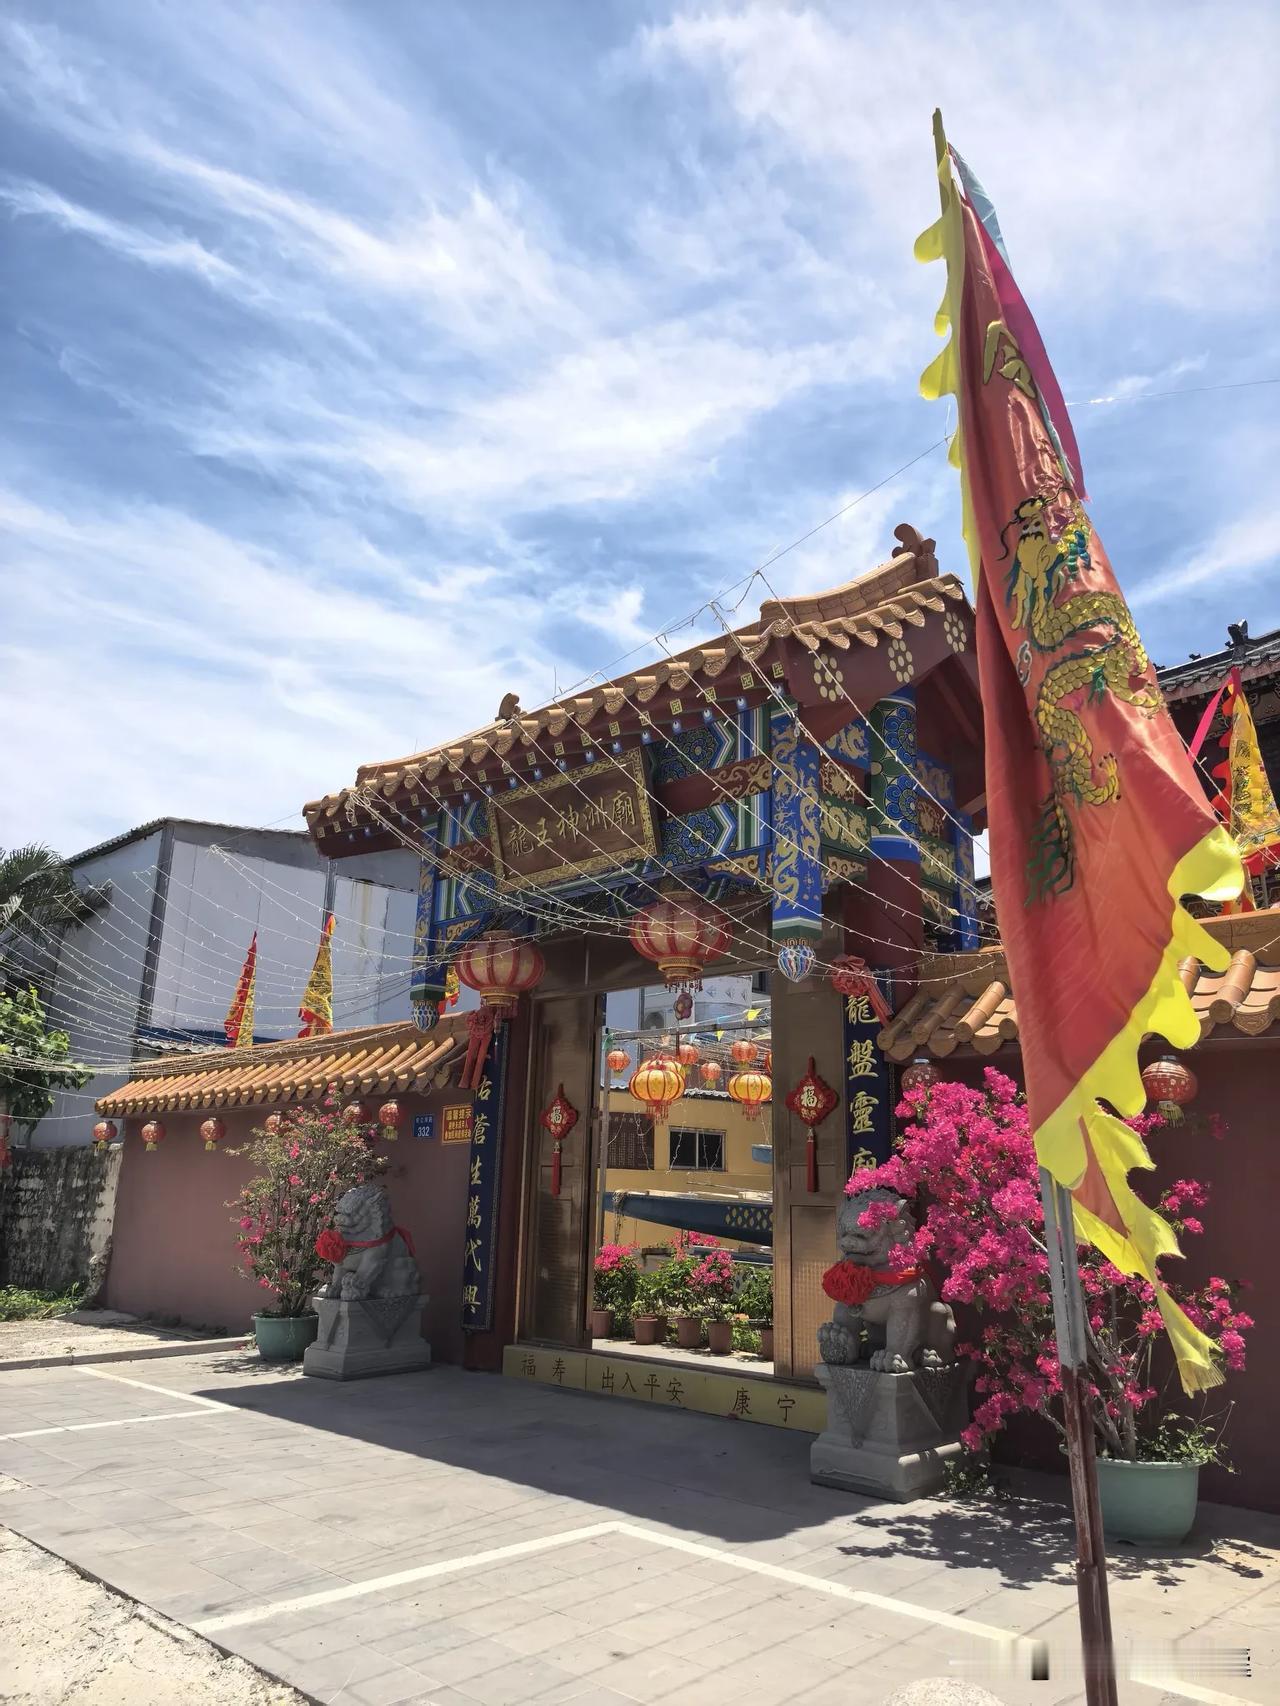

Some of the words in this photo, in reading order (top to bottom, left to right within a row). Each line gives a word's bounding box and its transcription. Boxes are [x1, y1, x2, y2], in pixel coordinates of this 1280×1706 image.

[800, 1085, 818, 1108] 福
[417, 1126, 430, 1137] 332
[462, 1054, 492, 1314] 佑蒼生萬代興
[521, 1354, 567, 1384] 福寿
[601, 1366, 685, 1405] 出入平安
[731, 1387, 796, 1424] 康宁
